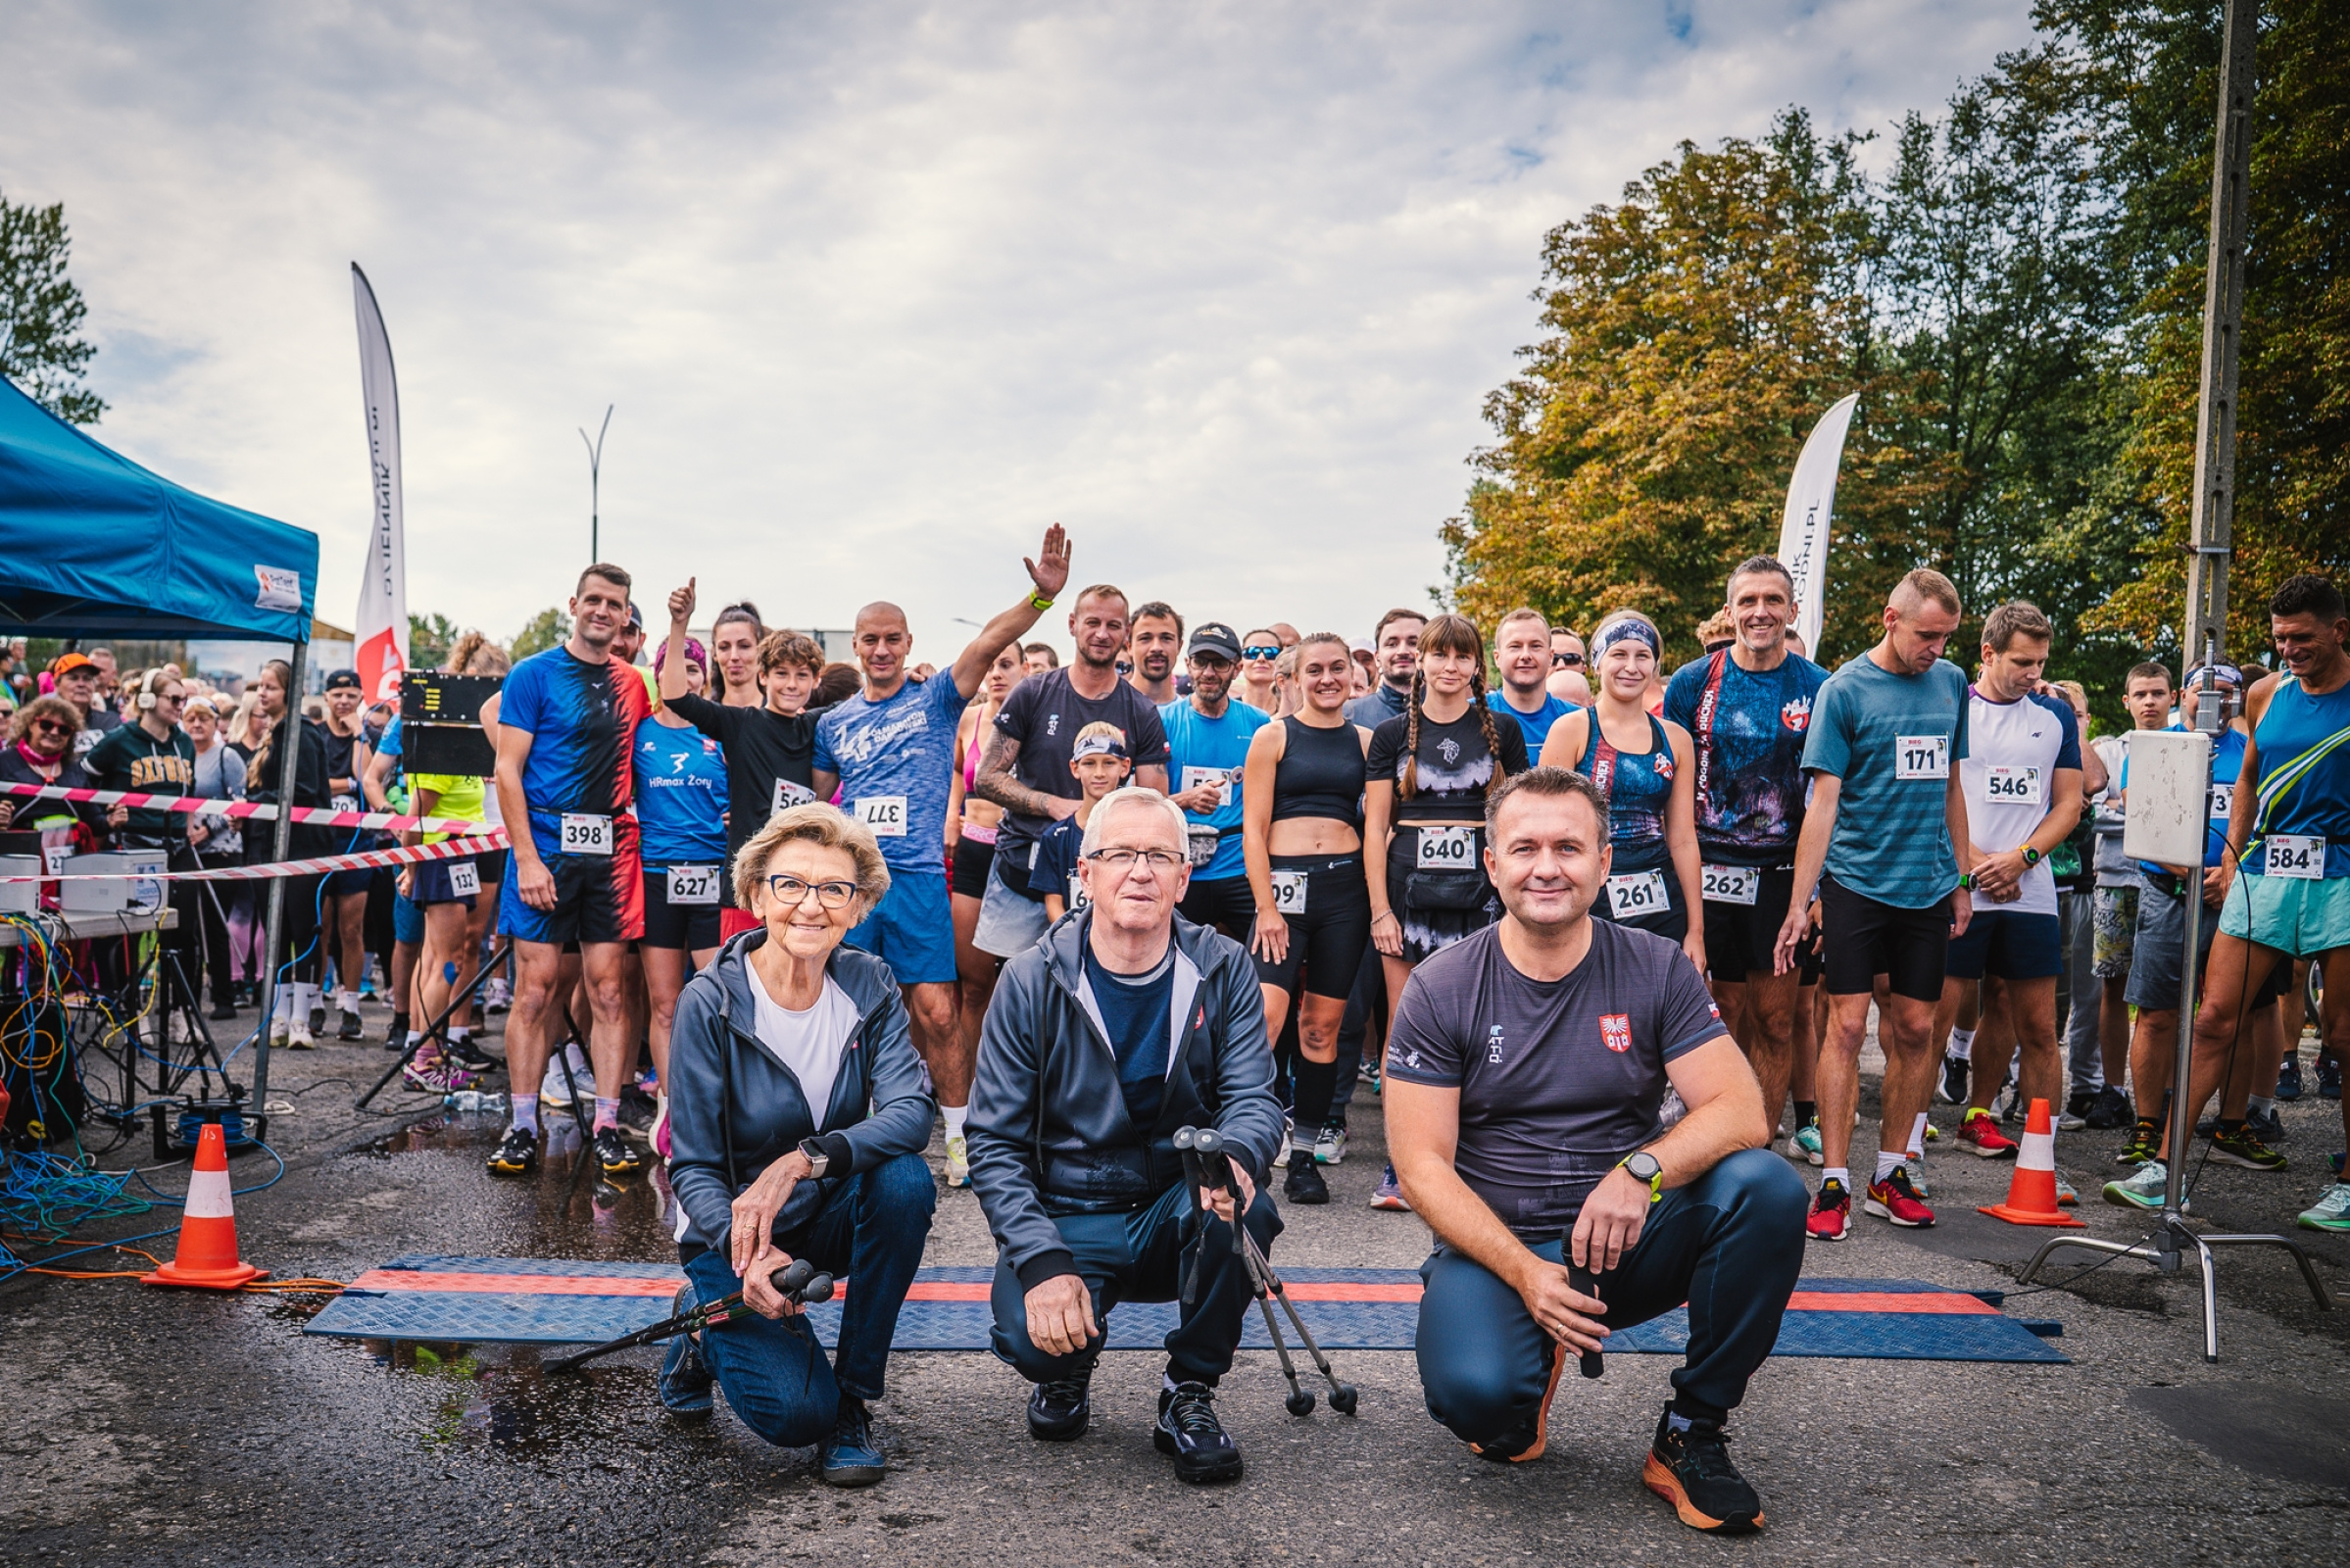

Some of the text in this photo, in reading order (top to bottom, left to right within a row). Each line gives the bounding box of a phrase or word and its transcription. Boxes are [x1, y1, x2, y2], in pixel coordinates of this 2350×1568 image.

[1904, 749, 1934, 770] 171
[649, 773, 711, 790] HRmax Żory
[1989, 776, 2028, 796] 546
[865, 804, 901, 824] 377
[566, 825, 602, 845] 398
[1422, 839, 1465, 859] 640
[2269, 848, 2310, 869] 584
[455, 873, 474, 890] 132
[673, 877, 708, 896] 627
[1703, 873, 1744, 896] 262
[1616, 883, 1654, 909] 261
